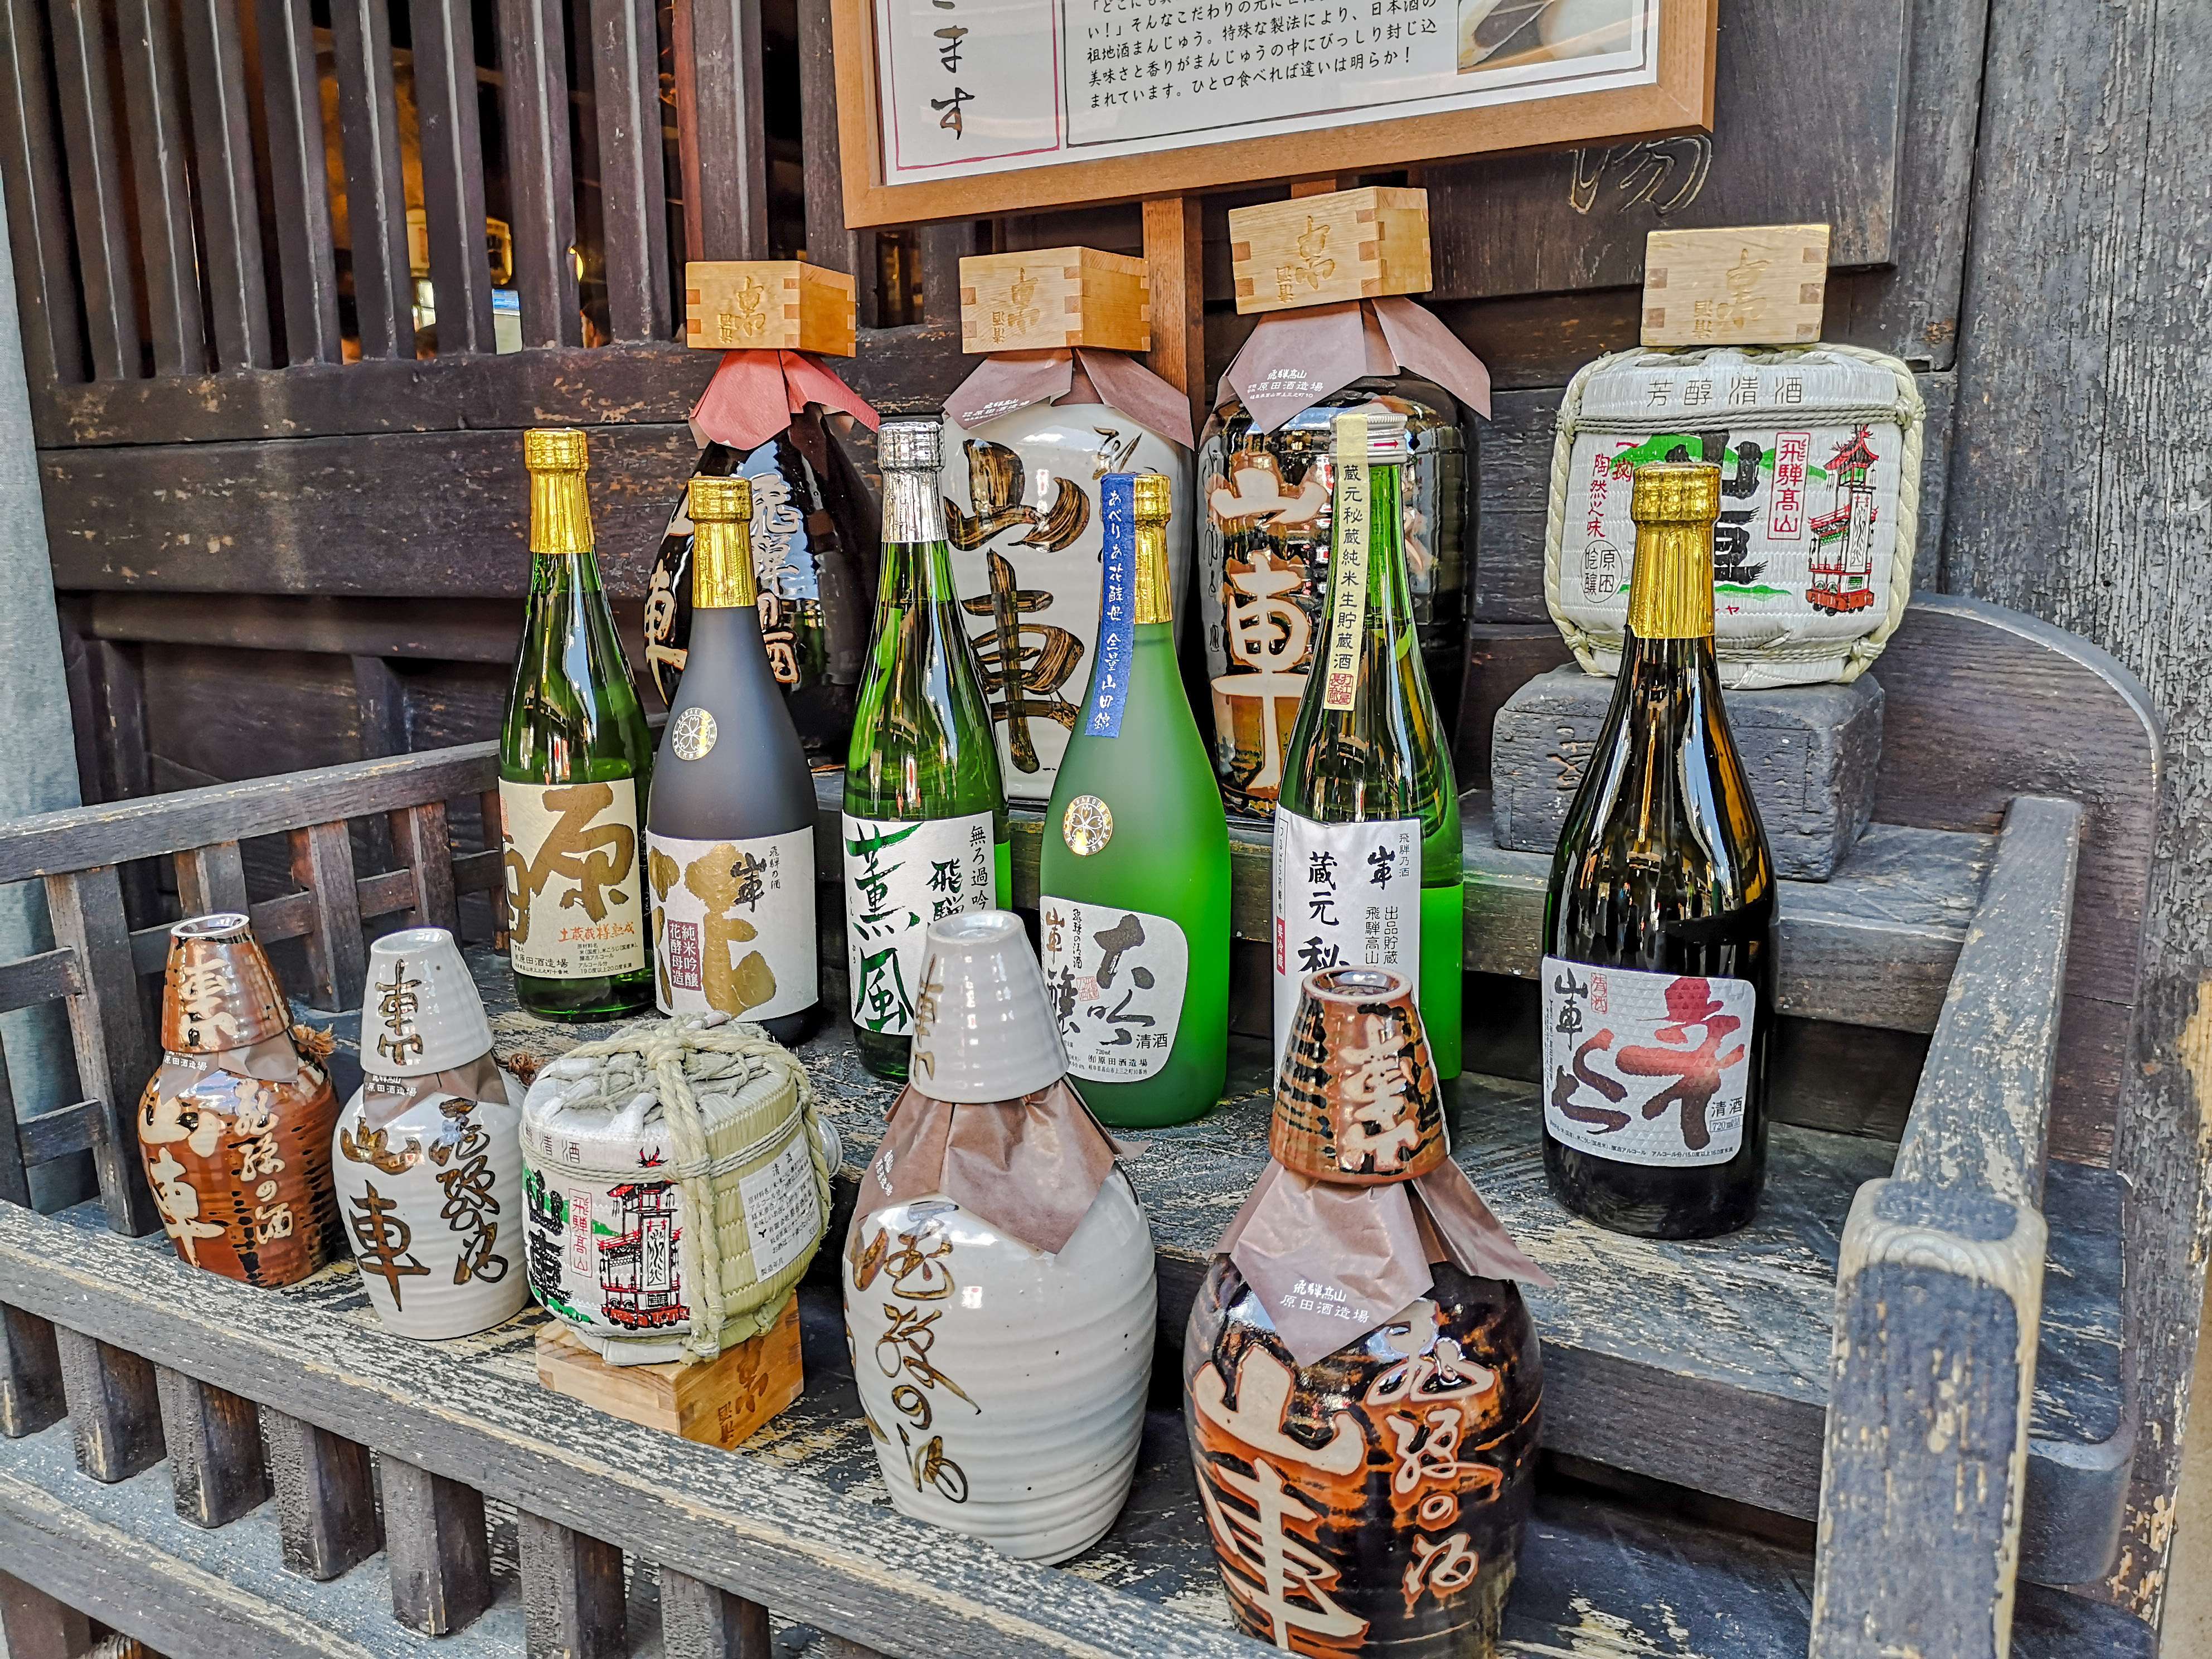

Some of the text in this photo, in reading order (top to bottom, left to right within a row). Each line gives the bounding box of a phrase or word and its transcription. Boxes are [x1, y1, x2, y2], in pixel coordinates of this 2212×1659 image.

[930, 0, 976, 140] ます
[1089, 18, 1437, 86] 美味さと香りがまんじゅうの中にびっしり封じ込
[1090, 46, 1411, 108] まれています。ひと口食べれば違いは明らか！
[1258, 381, 1323, 392] 原田酒造場
[1647, 376, 1803, 408] 芳醇清酒
[1332, 463, 1364, 671] 蔵元秘蔵純米生貯蔵酒
[944, 438, 1090, 775] 山車
[1209, 466, 1331, 789] 山車
[730, 852, 767, 913] 山車
[1367, 845, 1396, 890] 山車
[1398, 832, 1410, 878] 飛騨乃酒
[669, 923, 684, 986] 花酵母造
[681, 925, 699, 988] 純米吟醸
[844, 822, 925, 1035] 薫風
[1045, 906, 1066, 966] 山車
[1365, 905, 1380, 966] 飛騨高山
[1383, 905, 1399, 966] 出品貯蔵
[375, 958, 424, 1065] 山車
[1554, 967, 1588, 1051] 山車
[1136, 1032, 1168, 1049] 清酒
[1711, 1096, 1743, 1118] 清酒
[339, 1115, 431, 1312] 山車
[1279, 1293, 1370, 1324] 原田酒造場
[1194, 1342, 1370, 1651] 山車
